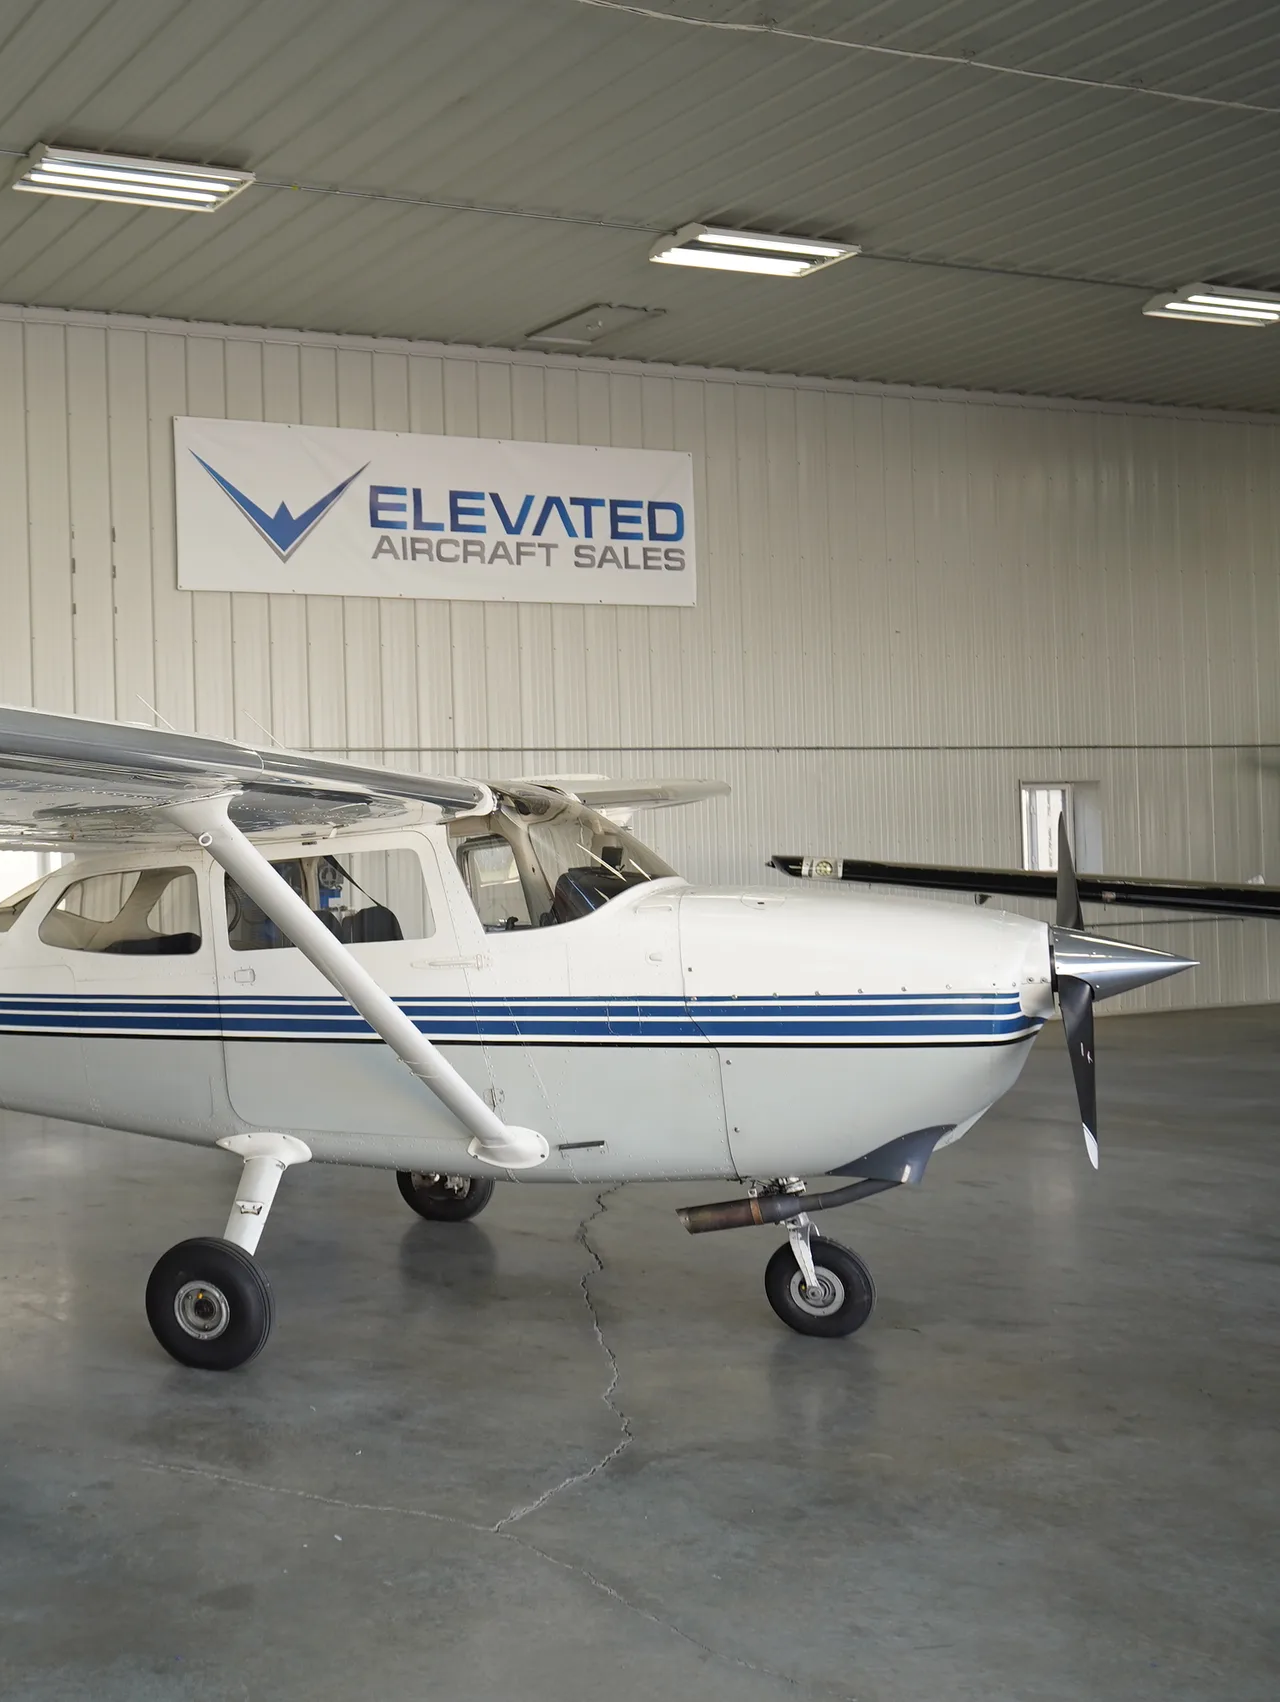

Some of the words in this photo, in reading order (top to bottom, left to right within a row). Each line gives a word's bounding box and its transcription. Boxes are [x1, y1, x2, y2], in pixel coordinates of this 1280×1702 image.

[369, 484, 685, 542] ELEVATED
[371, 534, 559, 567] AIRCRAFT
[573, 543, 686, 571] SALES
